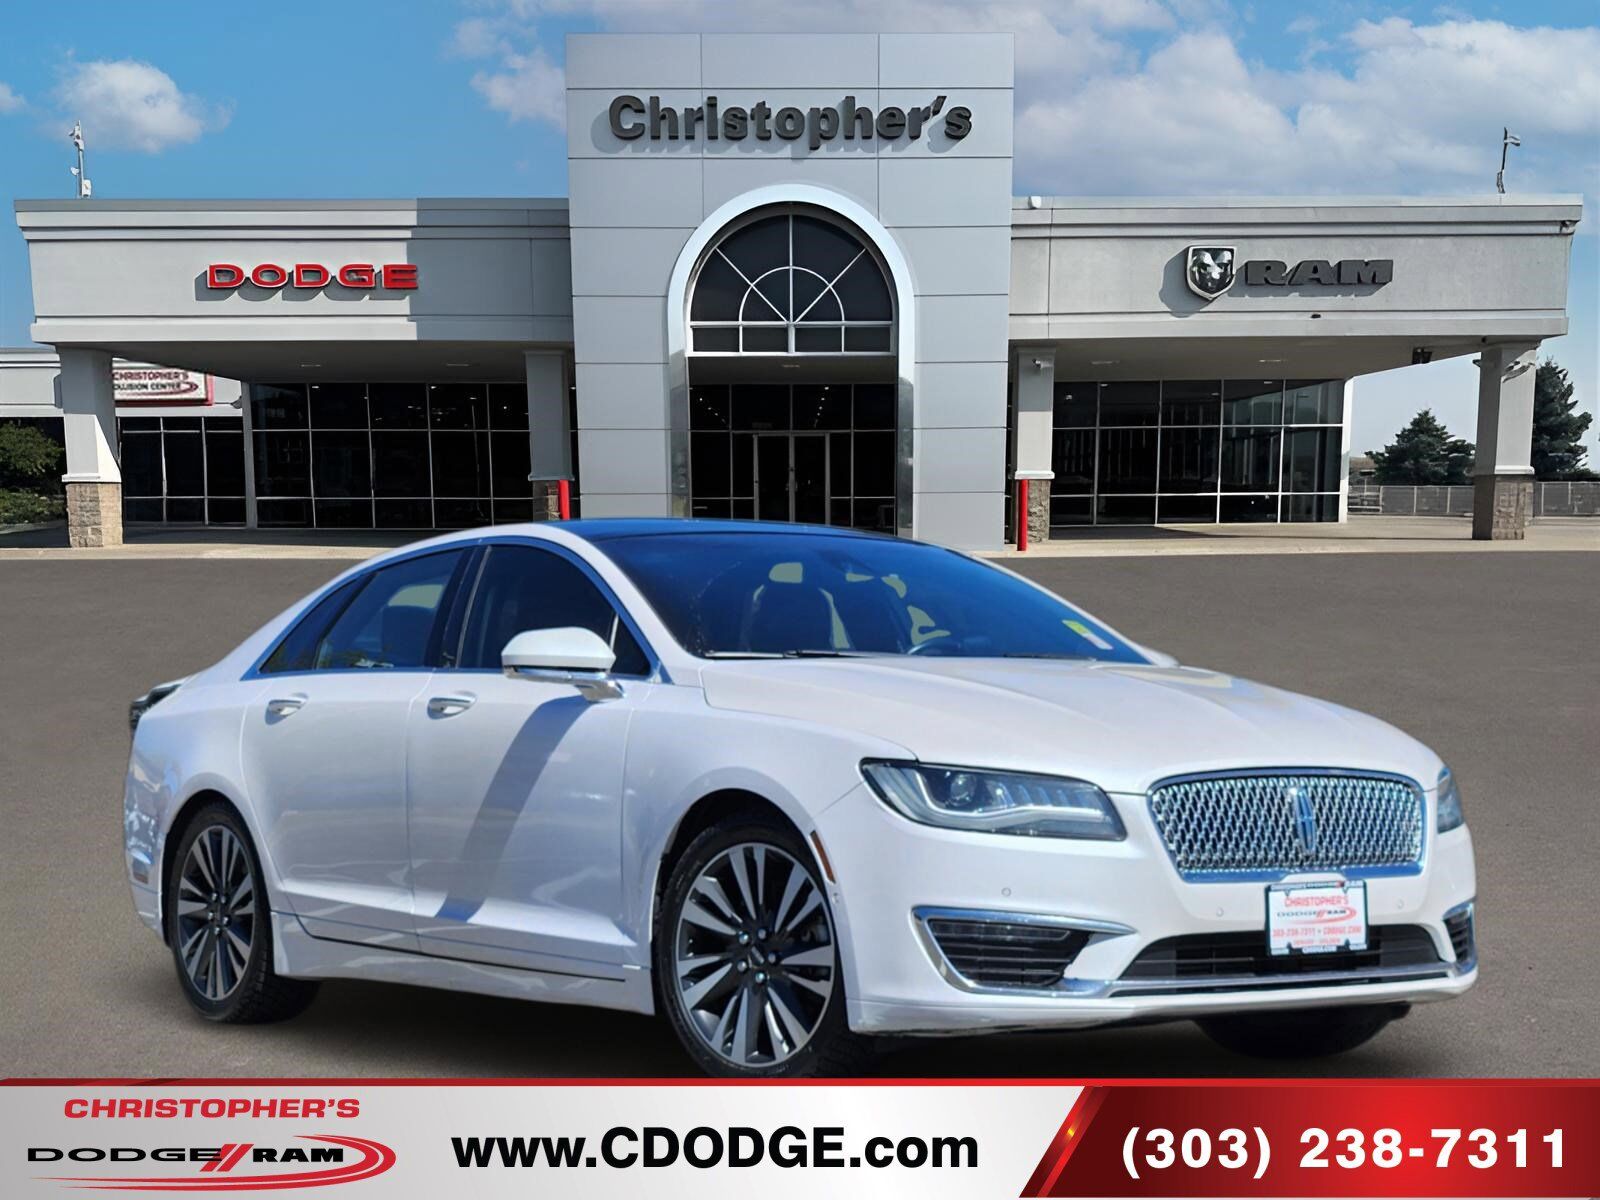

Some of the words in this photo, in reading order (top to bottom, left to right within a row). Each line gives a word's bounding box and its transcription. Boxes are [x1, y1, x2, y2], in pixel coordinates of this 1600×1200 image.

[609, 94, 972, 150] Christopher's
[207, 264, 418, 289] DODGE
[1245, 259, 1393, 286] RAM
[112, 383, 149, 391] OLLISION
[150, 382, 181, 390] CENTER
